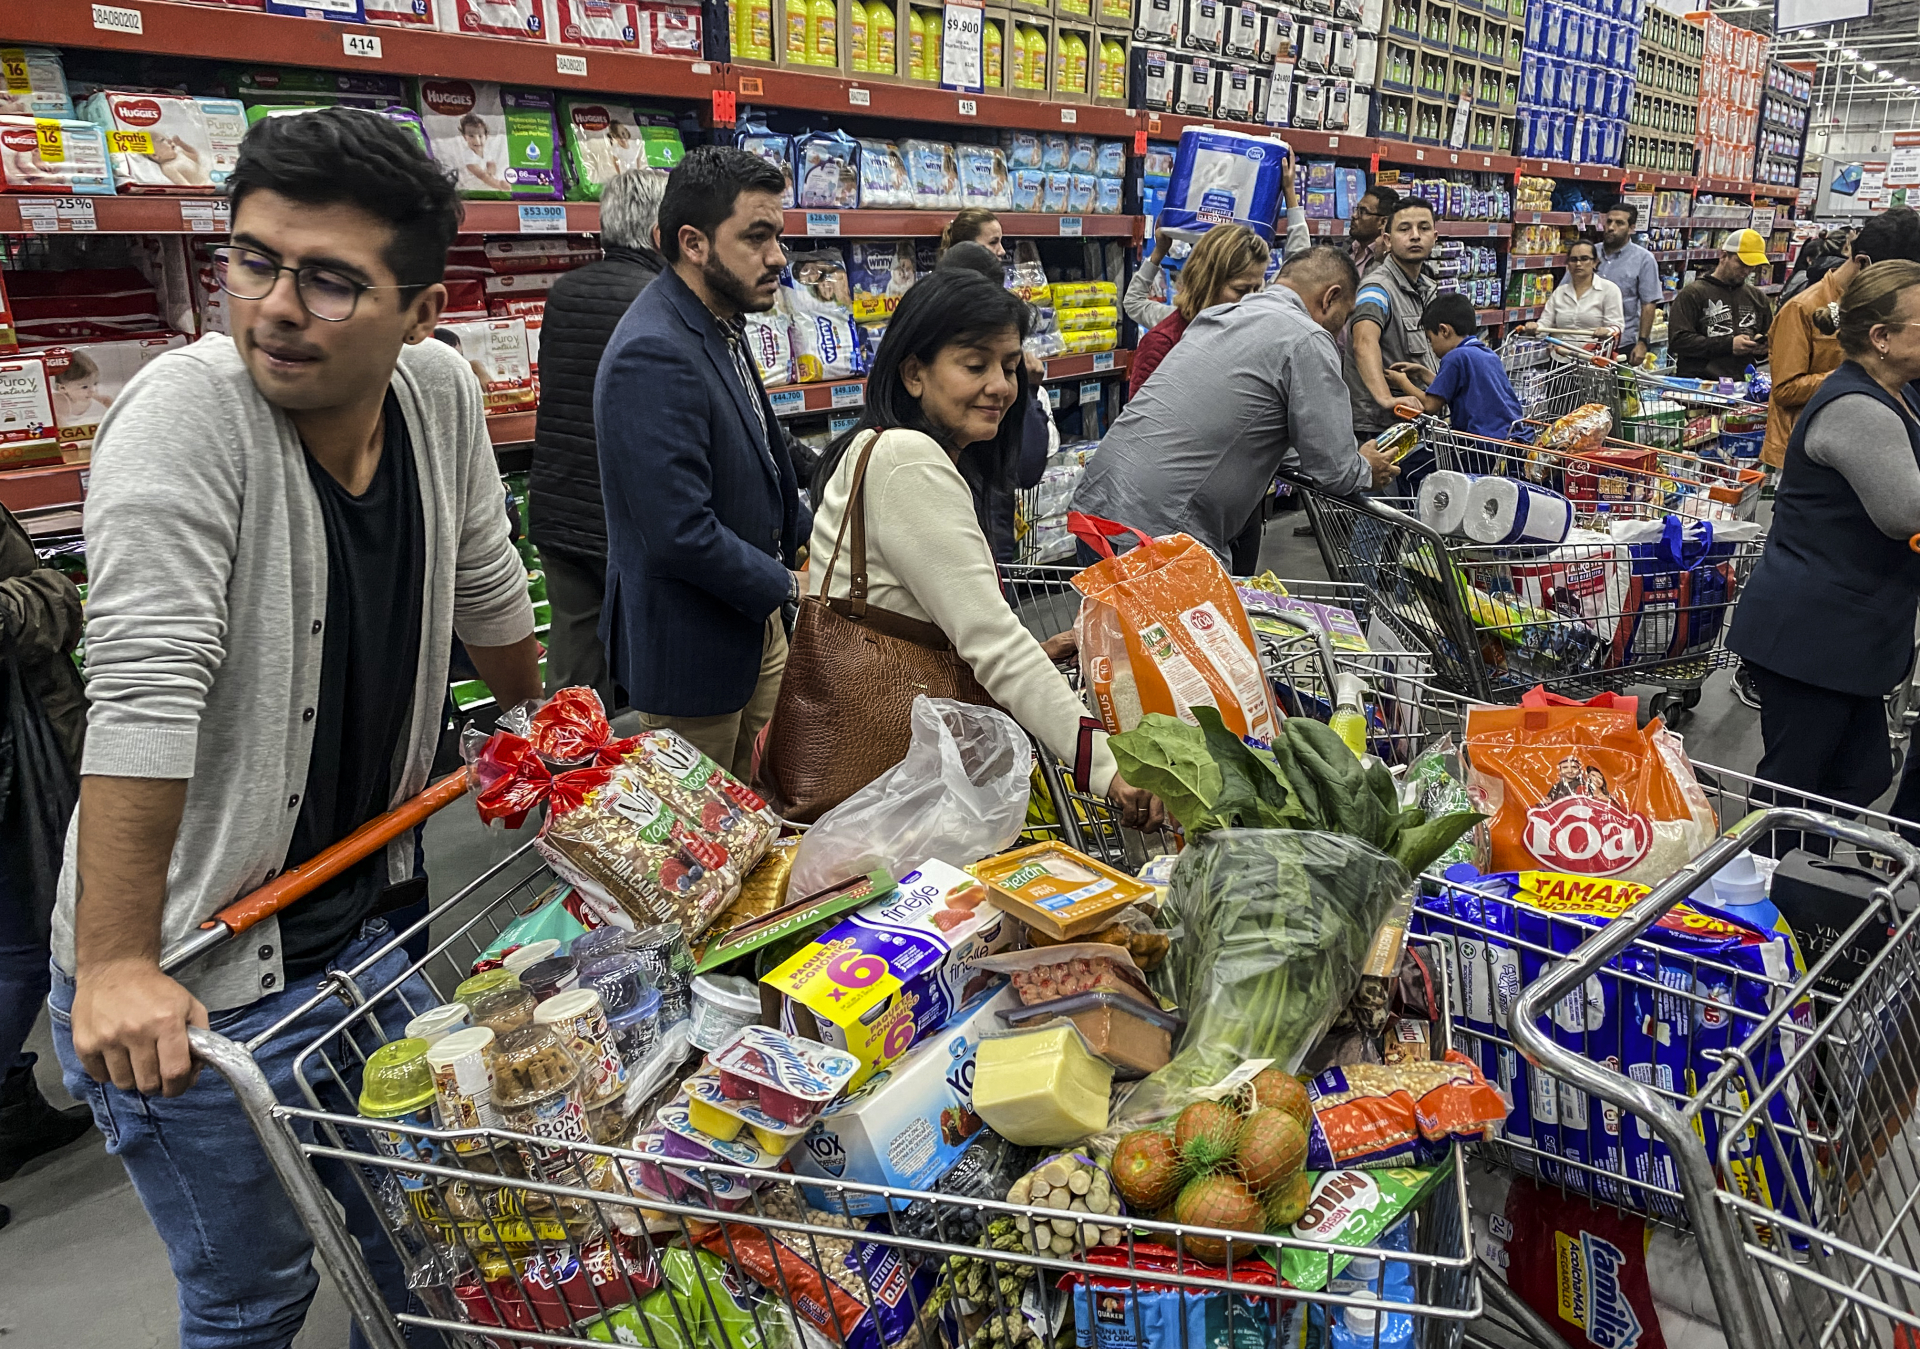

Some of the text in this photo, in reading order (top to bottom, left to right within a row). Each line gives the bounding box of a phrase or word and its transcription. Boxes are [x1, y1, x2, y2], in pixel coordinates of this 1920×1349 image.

[529, 17, 539, 27] 12
[947, 19, 979, 34] $9.900
[624, 28, 634, 37] 12
[349, 37, 375, 51] 414
[8, 64, 24, 76] 16
[427, 89, 473, 107] HUGGIES
[118, 107, 159, 119] HUGGIES
[962, 102, 974, 111] 415
[574, 112, 608, 124] HUGGIES
[4, 134, 38, 146] HUGGIES
[42, 131, 58, 143] 16
[113, 132, 147, 143] Gratis
[115, 142, 129, 152] 16
[57, 198, 93, 210] 25%
[214, 201, 229, 211] 25
[523, 207, 561, 217] $53.900
[809, 214, 837, 223] $28.900
[869, 254, 893, 270] winny
[491, 334, 513, 343] Puro
[817, 316, 837, 364] winny
[491, 342, 520, 351] natural
[761, 324, 775, 369] winny
[46, 357, 69, 367] GIES
[30, 377, 36, 388] y
[773, 391, 801, 401] $44.700
[834, 386, 860, 395] $49.100
[1101, 694, 1117, 735] TIPLUS
[1601, 812, 1628, 826] arroz
[998, 865, 1047, 889] Pietrán
[612, 855, 633, 875] DÍA
[629, 873, 656, 903] CADA
[654, 897, 674, 923] DÍA
[1031, 886, 1058, 898] PAVO
[734, 908, 821, 950] VILASECA
[1815, 922, 1841, 939] VIN
[1793, 928, 1872, 966] EYEND
[789, 939, 841, 982] PAQUETE
[791, 937, 857, 991] ECONÓMICO
[869, 990, 913, 1035] PAQUETE
[864, 993, 921, 1049] ECONÓMICO
[946, 1066, 976, 1097] YO
[535, 1110, 575, 1139] BON
[803, 1134, 847, 1158] YOX
[1297, 1171, 1368, 1231] MILO
[1491, 1215, 1505, 1236] 24
[741, 1257, 770, 1279] GARBANZO
[1560, 1246, 1571, 1308] MEGAROLLO
[1568, 1240, 1585, 1322] AcolchaMAX
[1589, 1237, 1630, 1349] familia
[802, 1294, 831, 1319] ALKOSTO
[1097, 1309, 1124, 1320] QUAKER
[1113, 1333, 1151, 1345] ORIGIAL
[1118, 1328, 1130, 1336] EN
